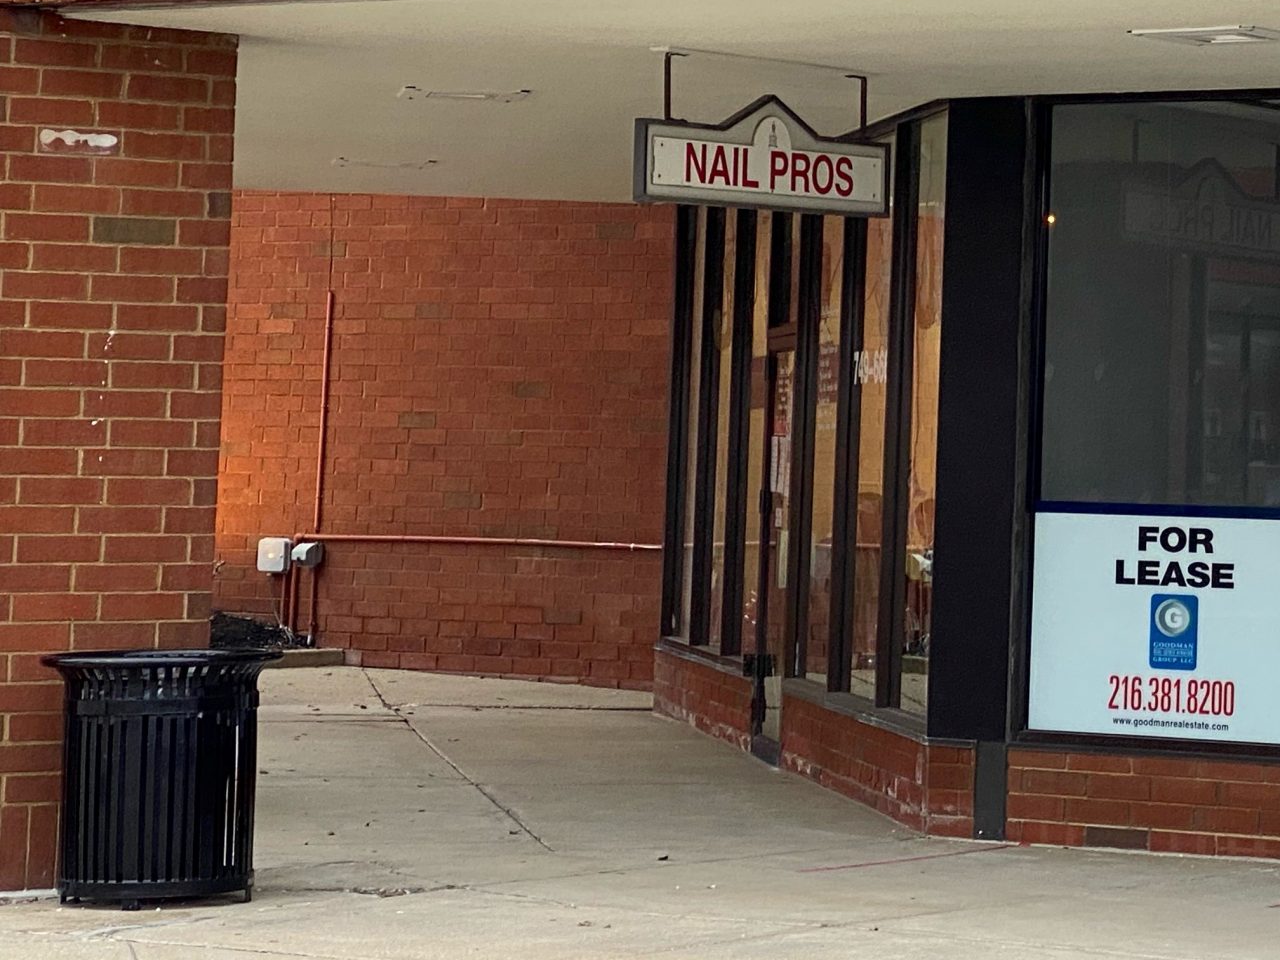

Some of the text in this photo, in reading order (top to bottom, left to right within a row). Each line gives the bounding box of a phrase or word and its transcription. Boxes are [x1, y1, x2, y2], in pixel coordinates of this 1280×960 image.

[685, 142, 854, 197] NAIL PROS
[1138, 526, 1214, 554] FOR
[1115, 559, 1235, 589] LEASE
[1152, 641, 1194, 650] GOODMAN
[1152, 656, 1178, 664] GROUP
[1108, 674, 1235, 717] 216.381.8200
[1112, 717, 1229, 732] www.goodmanrealestate.com
